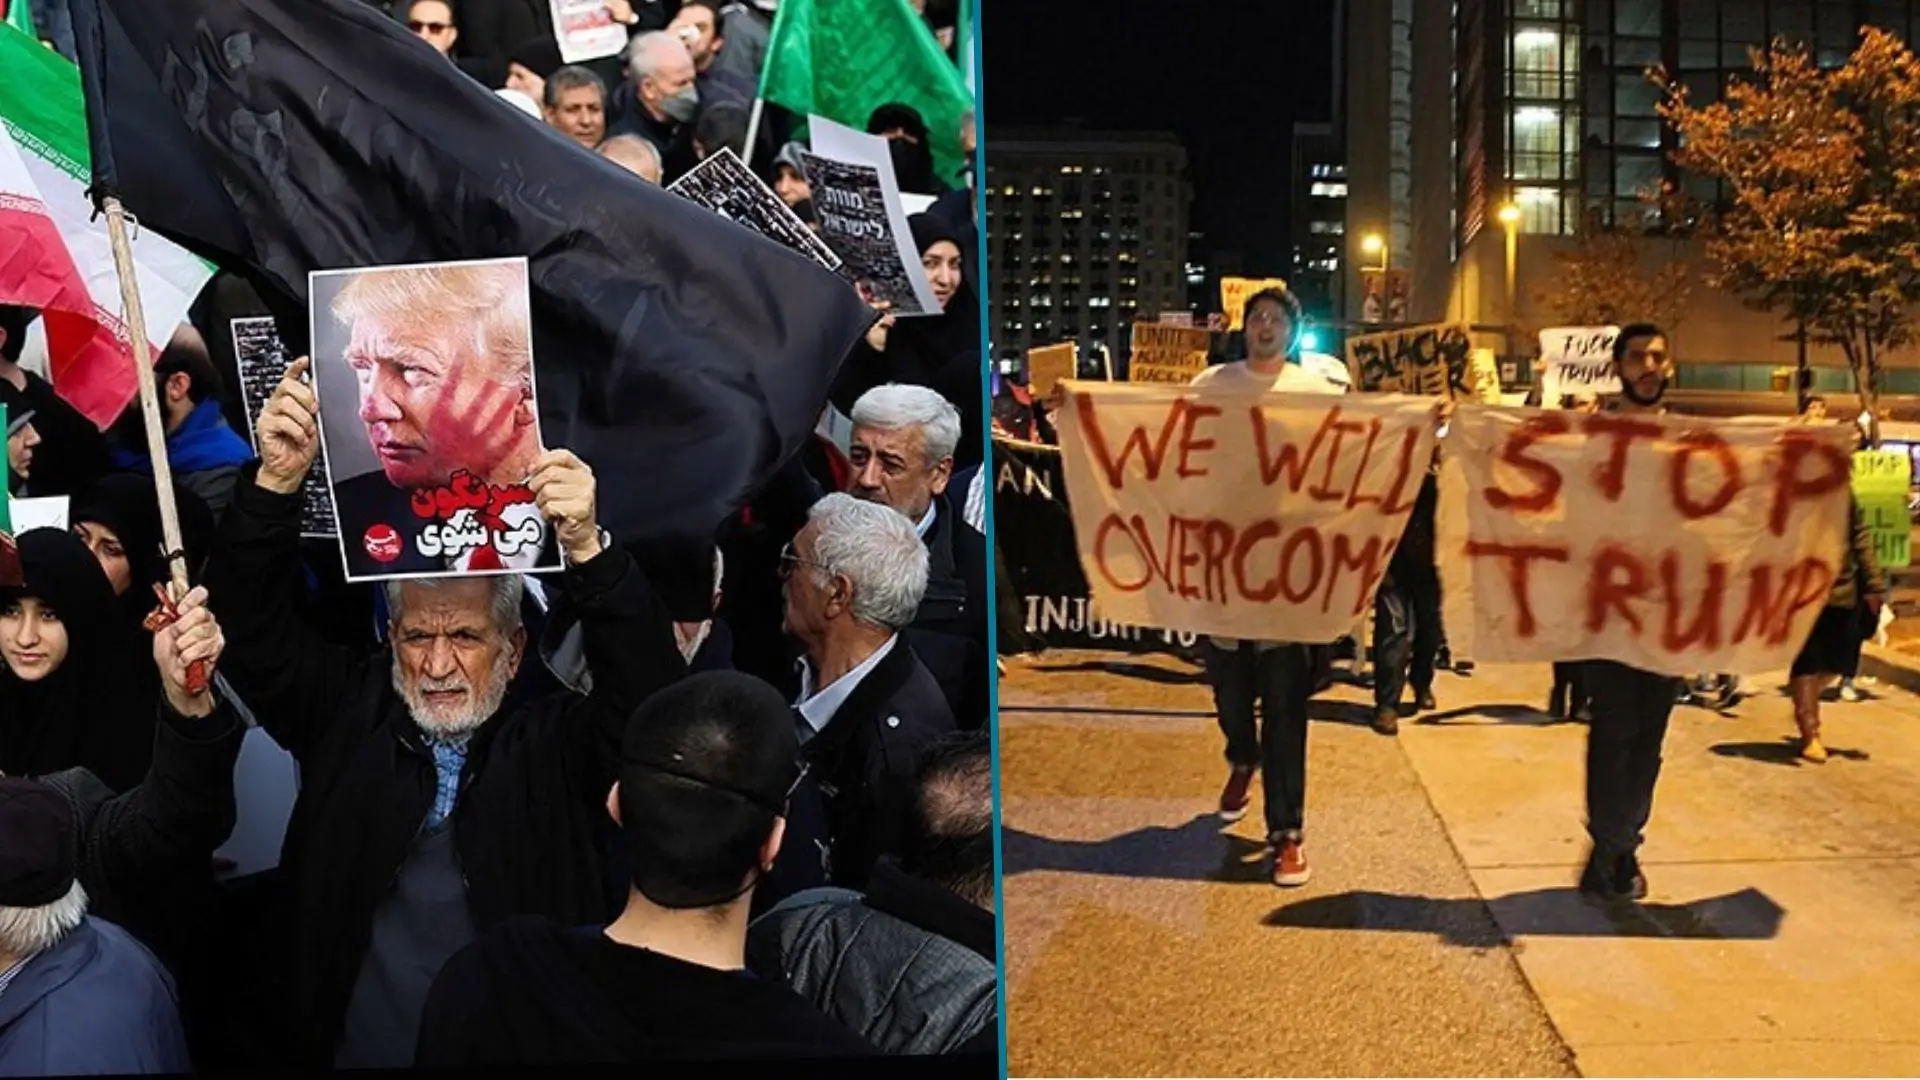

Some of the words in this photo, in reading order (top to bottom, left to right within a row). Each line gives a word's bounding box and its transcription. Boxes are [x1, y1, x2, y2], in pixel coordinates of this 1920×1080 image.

[996, 461, 1053, 499] AN
[1075, 393, 1222, 490] WE
[1250, 403, 1420, 515] WILL
[1484, 410, 1850, 537] STOP
[1464, 538, 1833, 654] TRUMP
